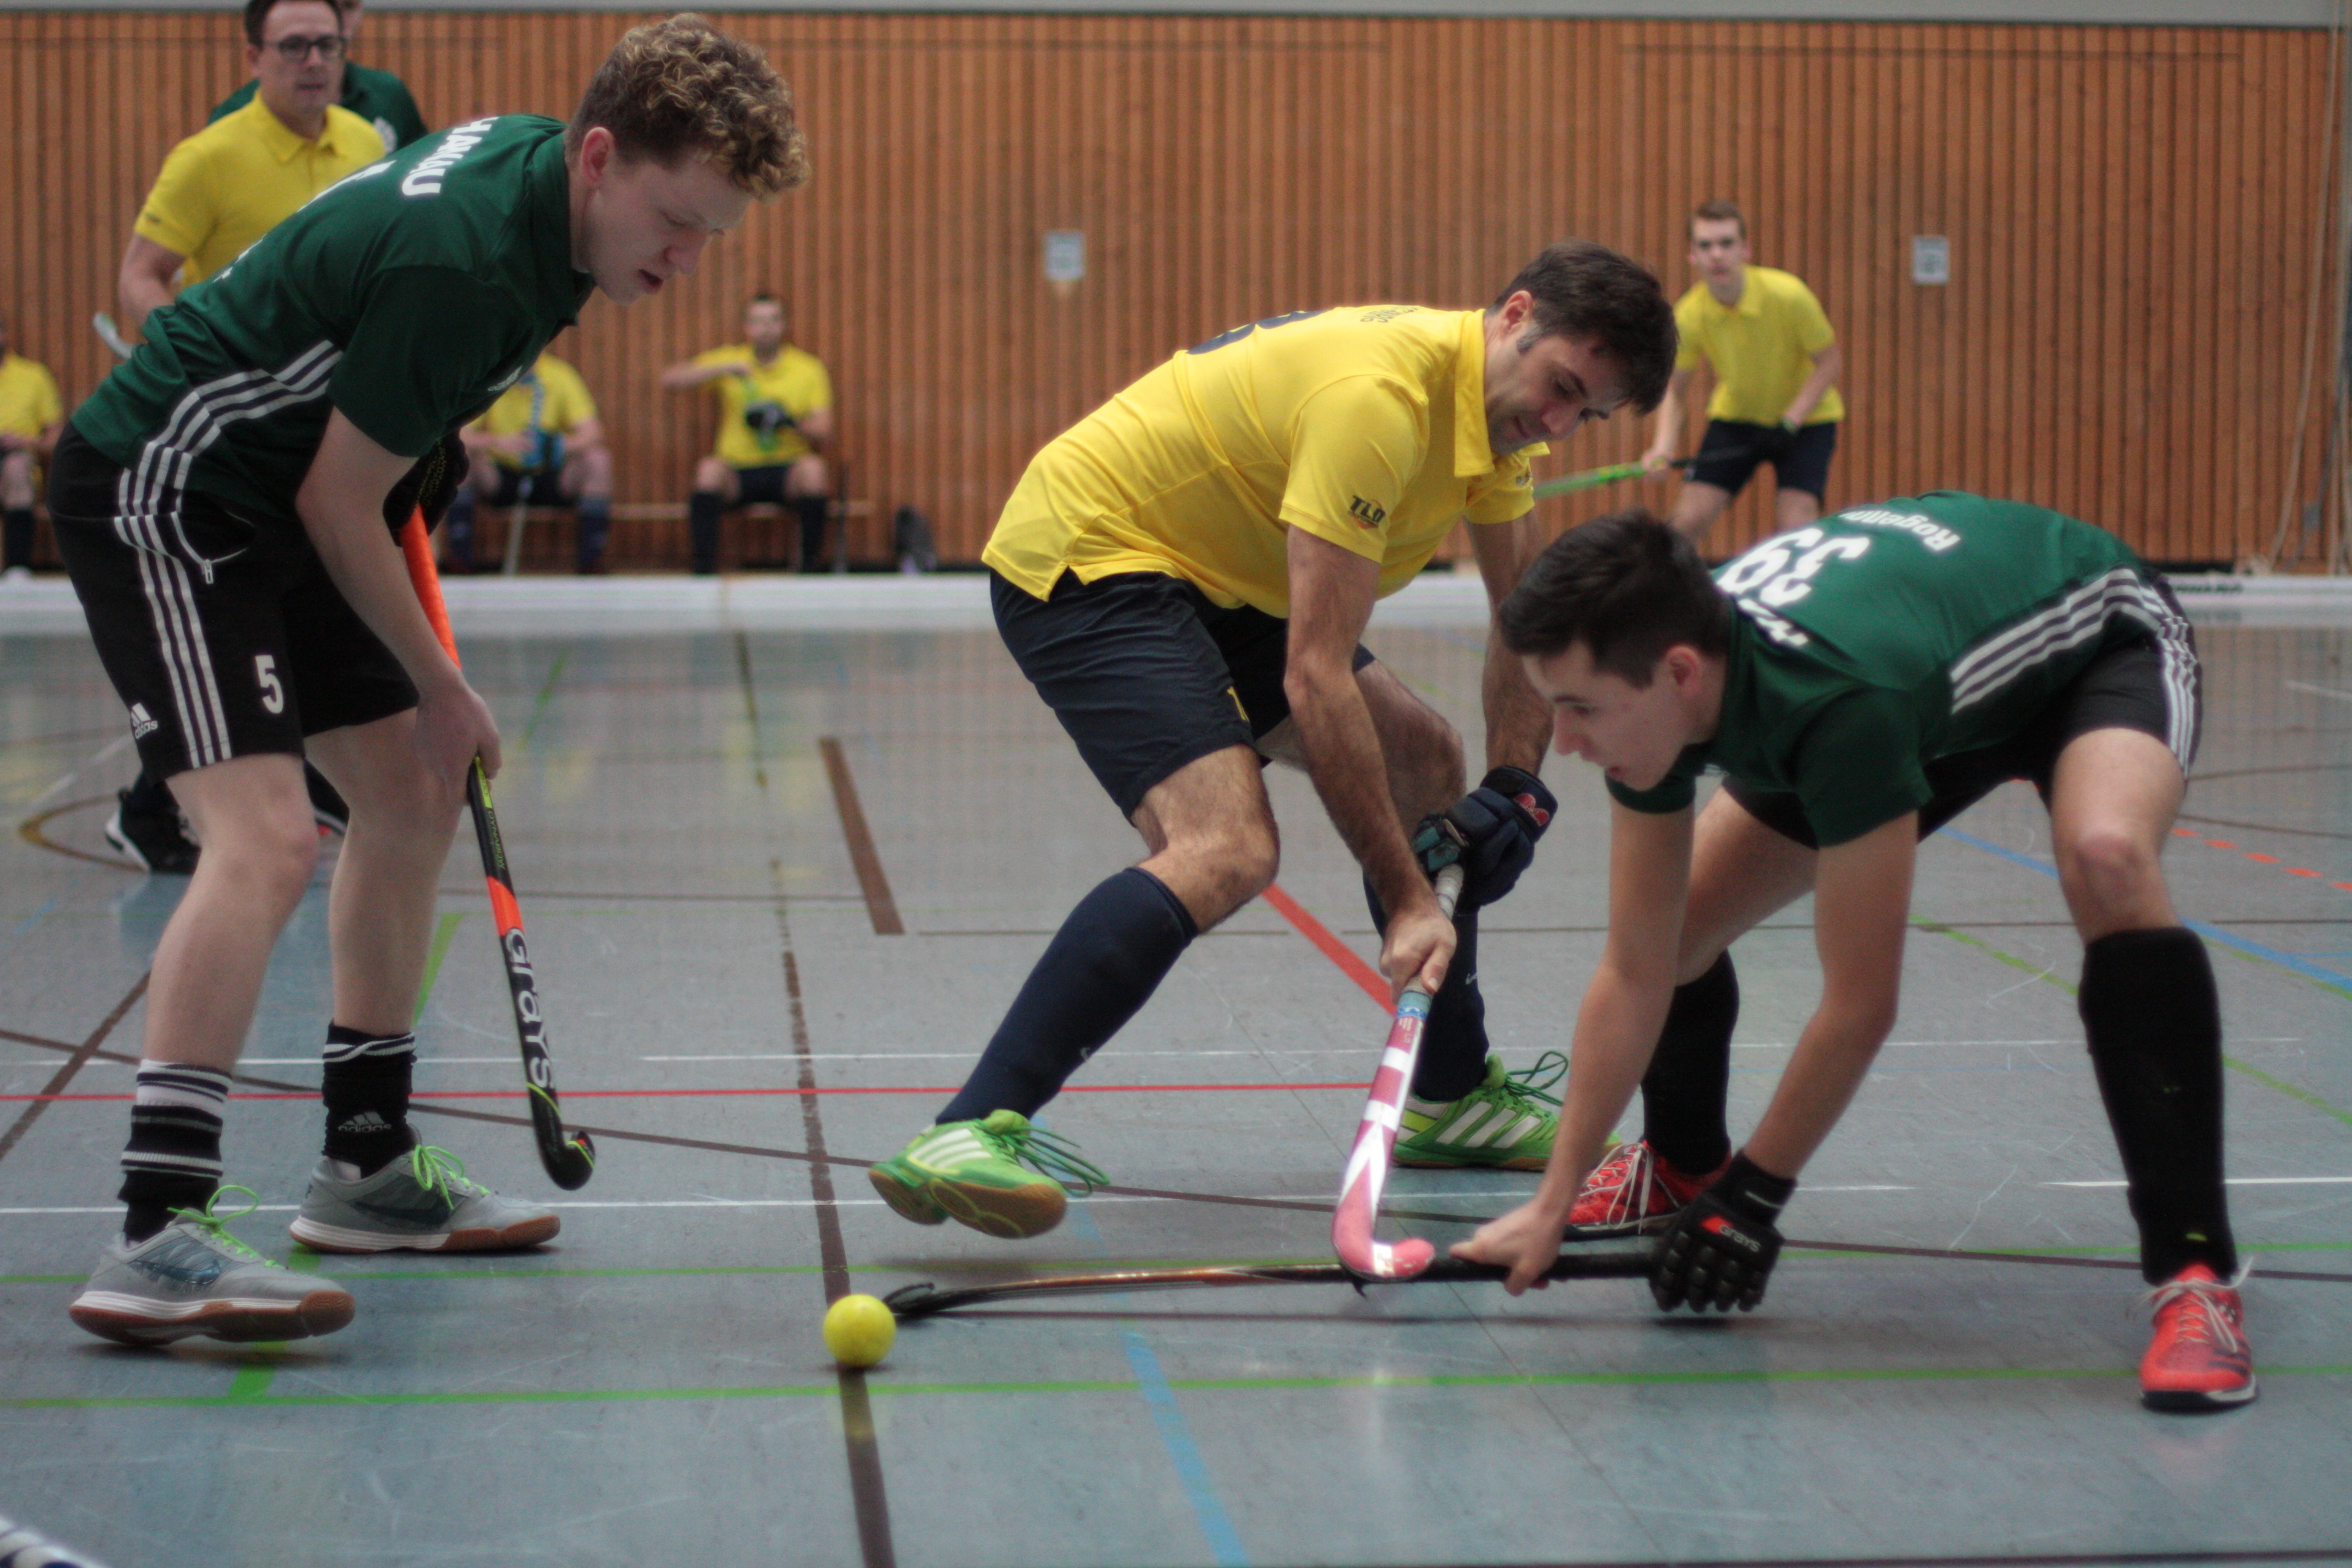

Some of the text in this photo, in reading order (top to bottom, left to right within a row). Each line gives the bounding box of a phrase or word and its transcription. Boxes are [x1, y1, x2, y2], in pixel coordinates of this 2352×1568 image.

[402, 116, 499, 196] HANAU
[1717, 527, 1870, 607] 39
[255, 655, 284, 714] 5
